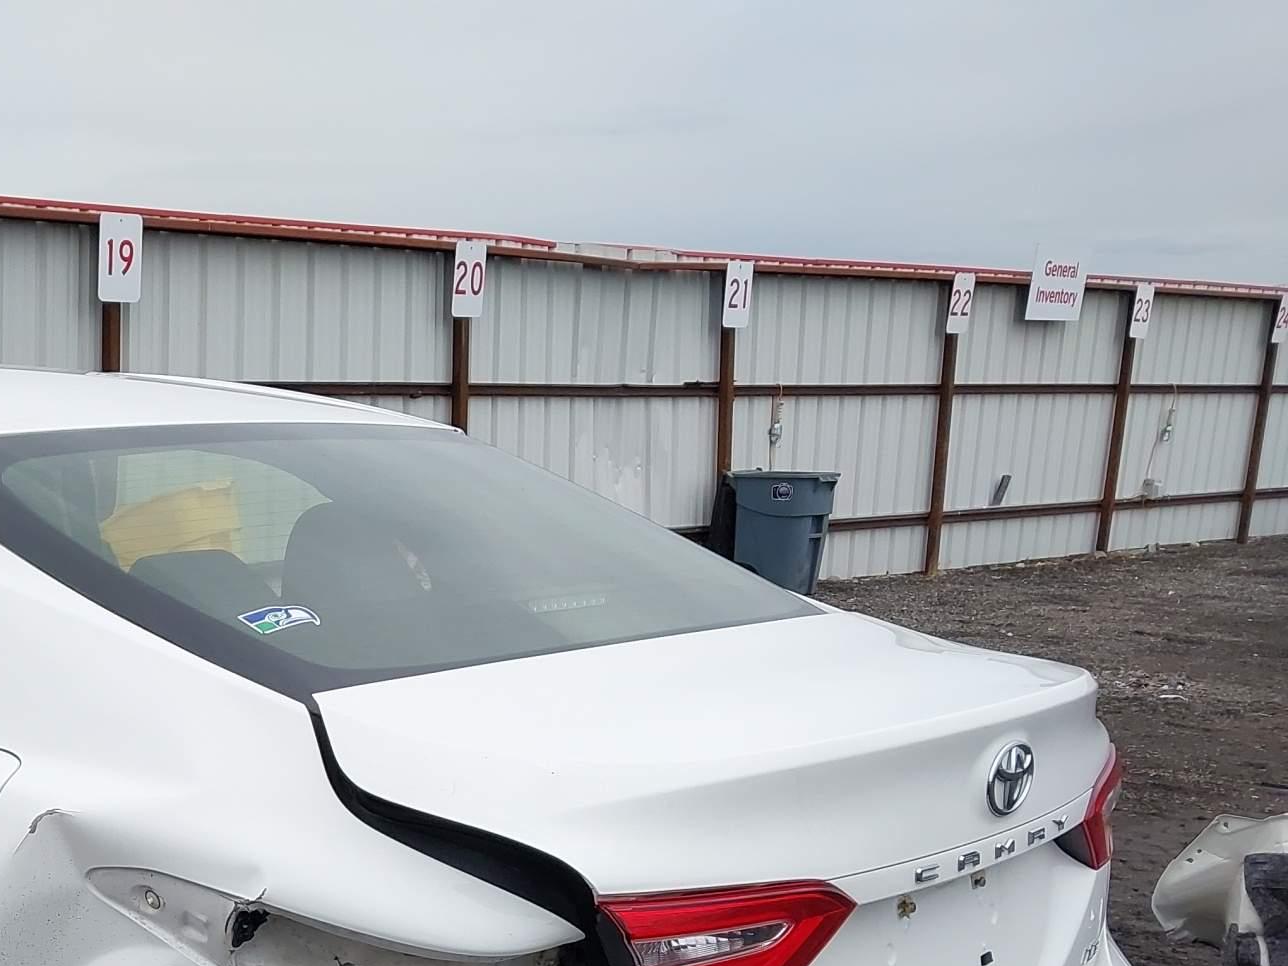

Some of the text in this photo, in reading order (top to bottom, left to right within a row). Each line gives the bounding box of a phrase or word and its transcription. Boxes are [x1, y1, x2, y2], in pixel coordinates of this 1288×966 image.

[106, 239, 135, 276] 19
[1044, 260, 1080, 279] General
[455, 260, 483, 296] 20
[728, 278, 748, 309] 21
[950, 288, 972, 316] 22
[1035, 286, 1078, 308] Inventory
[1133, 298, 1151, 323] 23
[915, 815, 1069, 882] CAMRY
